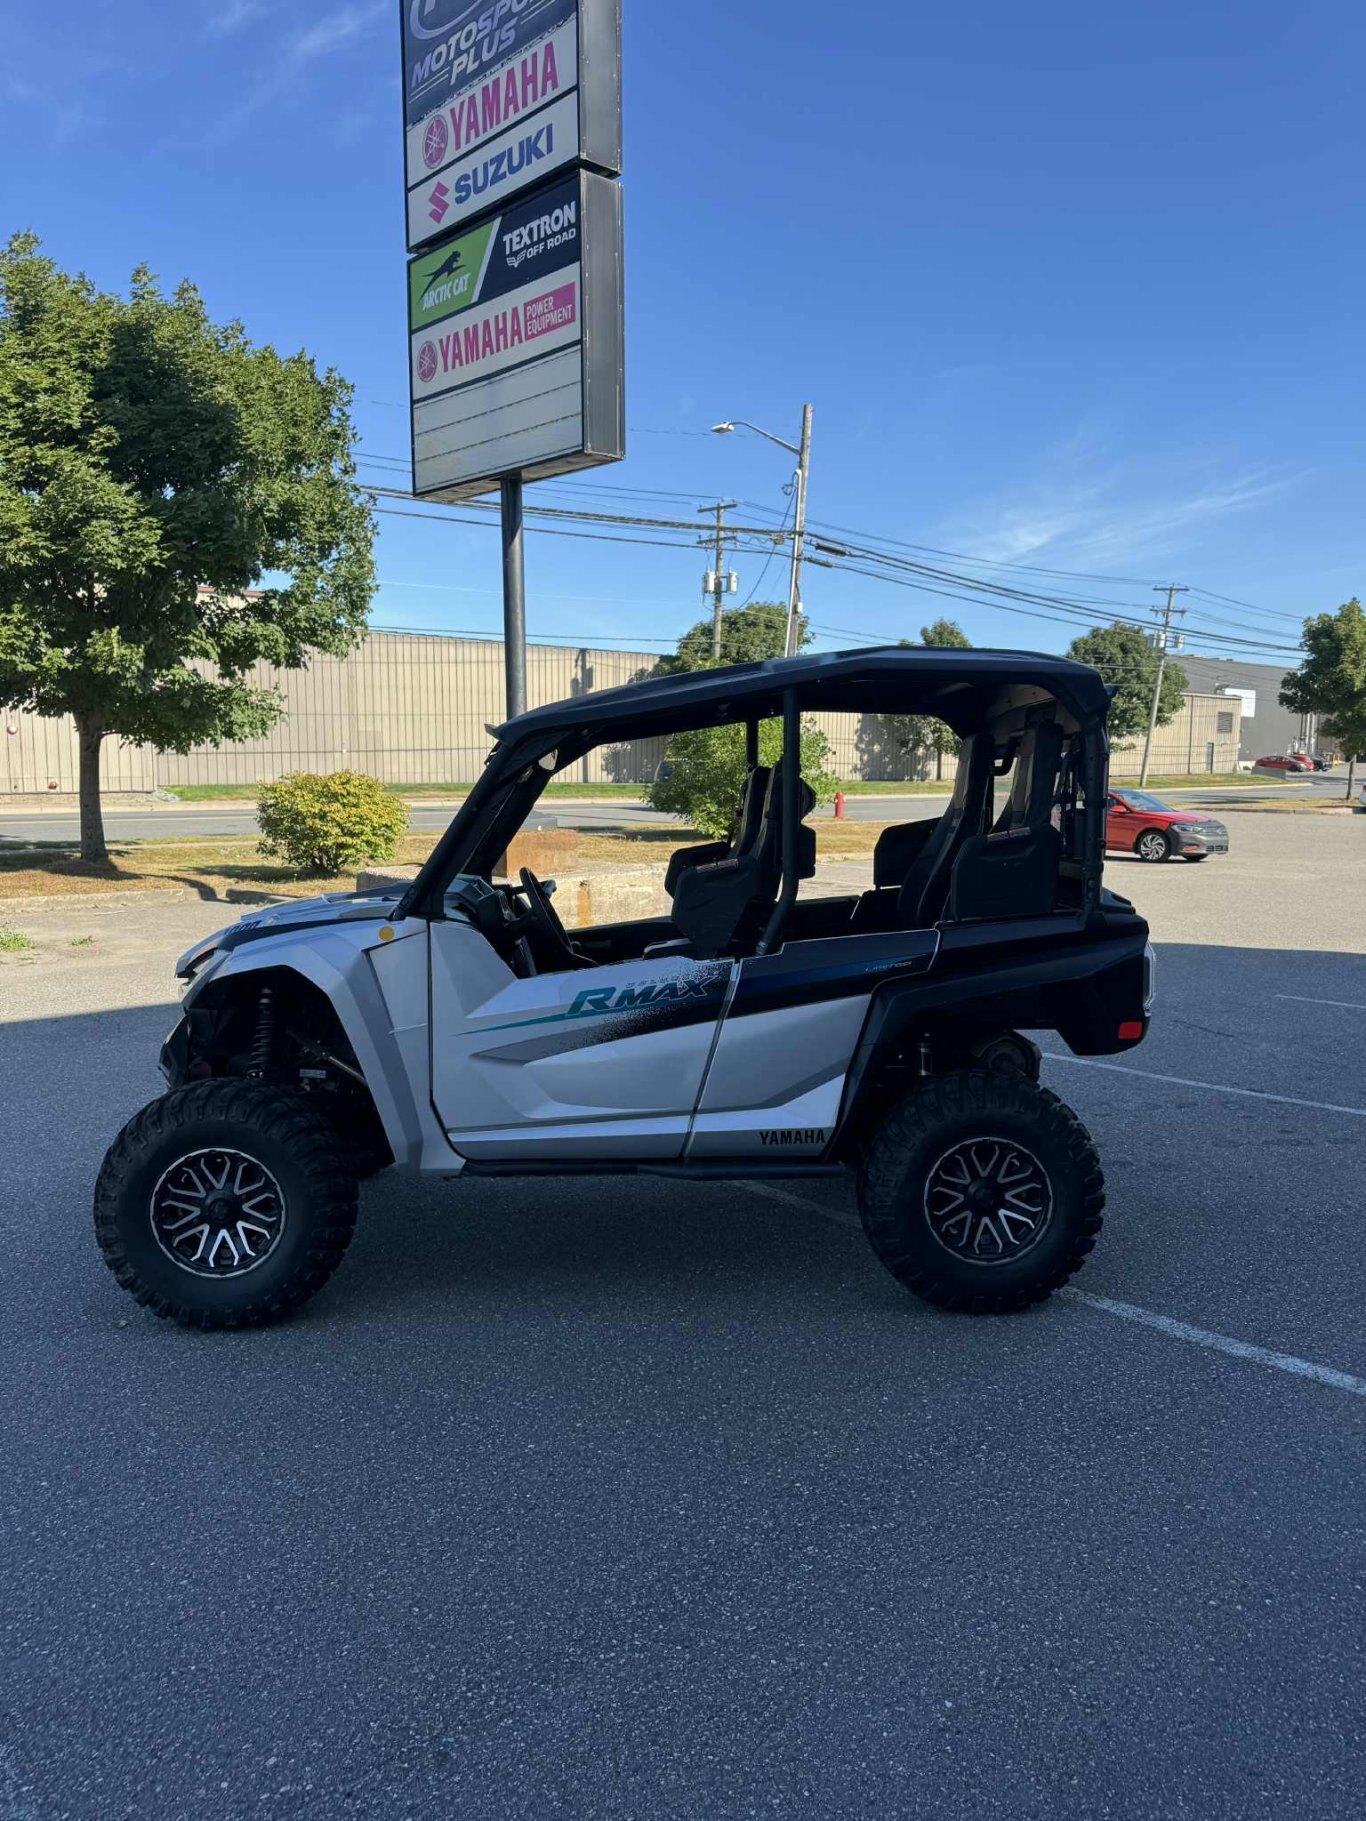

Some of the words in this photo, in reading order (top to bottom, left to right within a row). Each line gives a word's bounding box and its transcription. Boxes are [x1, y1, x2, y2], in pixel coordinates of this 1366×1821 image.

[411, 0, 533, 89] MOTOSPO
[450, 17, 518, 86] PLUS
[450, 41, 559, 152] YAMAHA
[454, 123, 554, 205] SUZUKI
[502, 201, 576, 255] TEXTRON
[526, 242, 545, 259] OFF
[547, 228, 576, 250] ROAD
[422, 280, 453, 311] ARCTIC
[452, 272, 471, 297] CAT
[526, 296, 554, 320] POWER
[439, 306, 523, 373] YAMAHA
[527, 304, 573, 336] EQUIPMENT
[565, 975, 720, 1016] RMAX
[760, 1130, 825, 1145] YAMAHA
